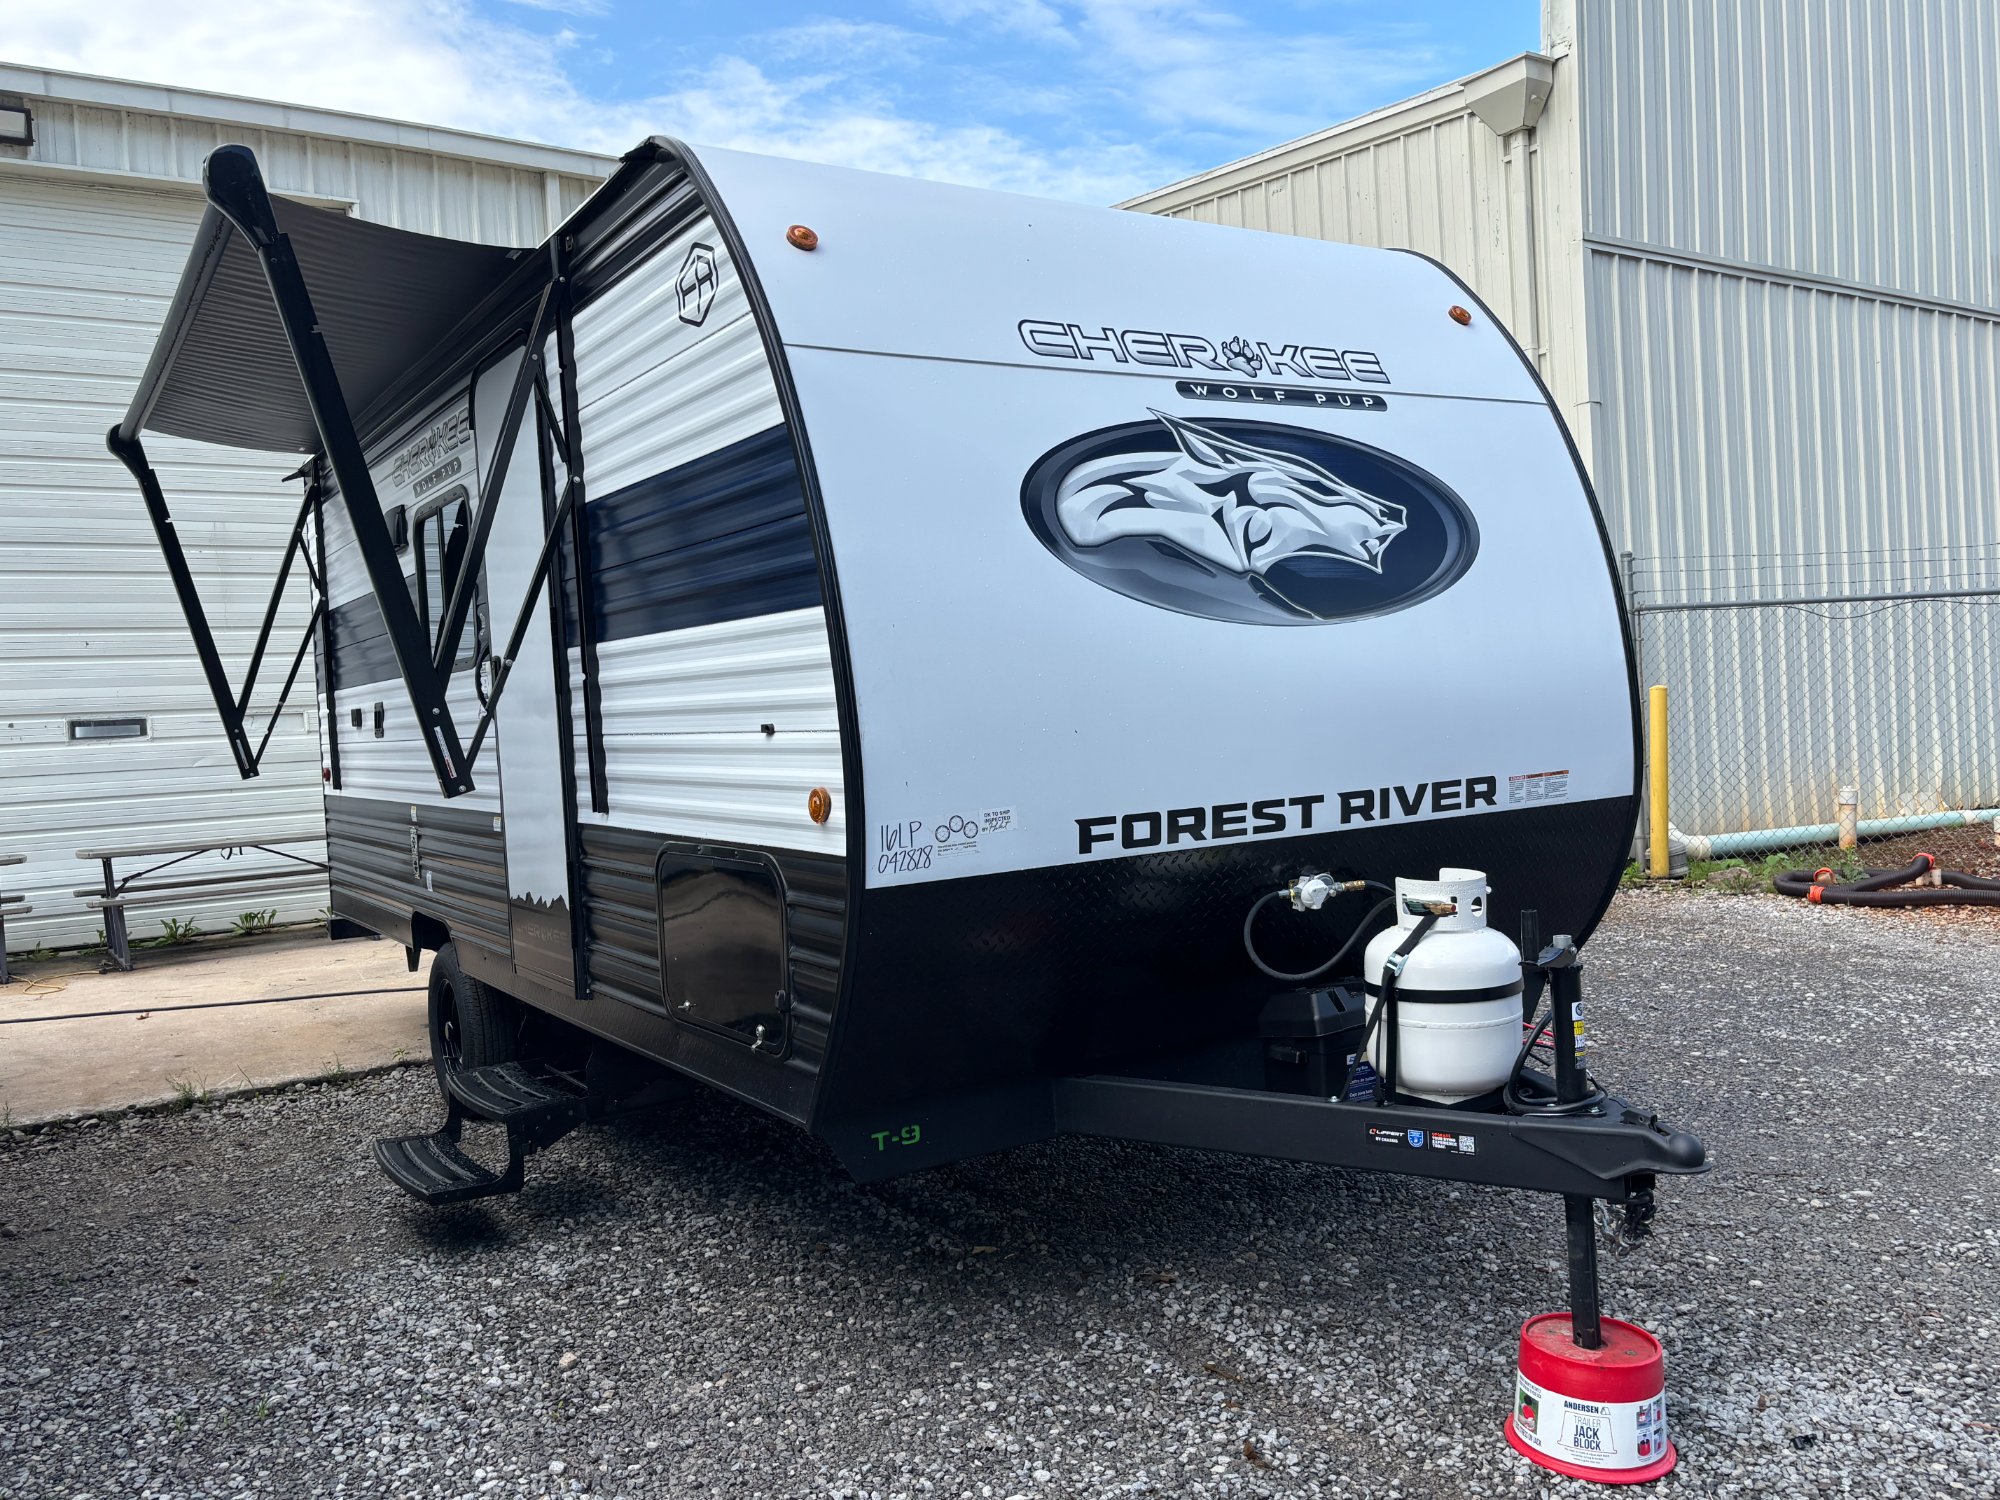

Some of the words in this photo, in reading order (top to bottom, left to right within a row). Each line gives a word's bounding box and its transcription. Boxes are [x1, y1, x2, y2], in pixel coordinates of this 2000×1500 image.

[1190, 384, 1285, 402] WOLF
[1314, 393, 1374, 408] PUP
[441, 461, 458, 477] PUP
[1074, 794, 1325, 854] FOREST
[1336, 775, 1497, 824] RIVER
[878, 845, 933, 874] 042828
[871, 1125, 920, 1151] T-9
[1564, 1400, 1599, 1414] ANDERSEN
[1574, 1415, 1601, 1428] TRAILER
[1574, 1425, 1600, 1440] JACK
[1574, 1437, 1601, 1451] BLOCK
